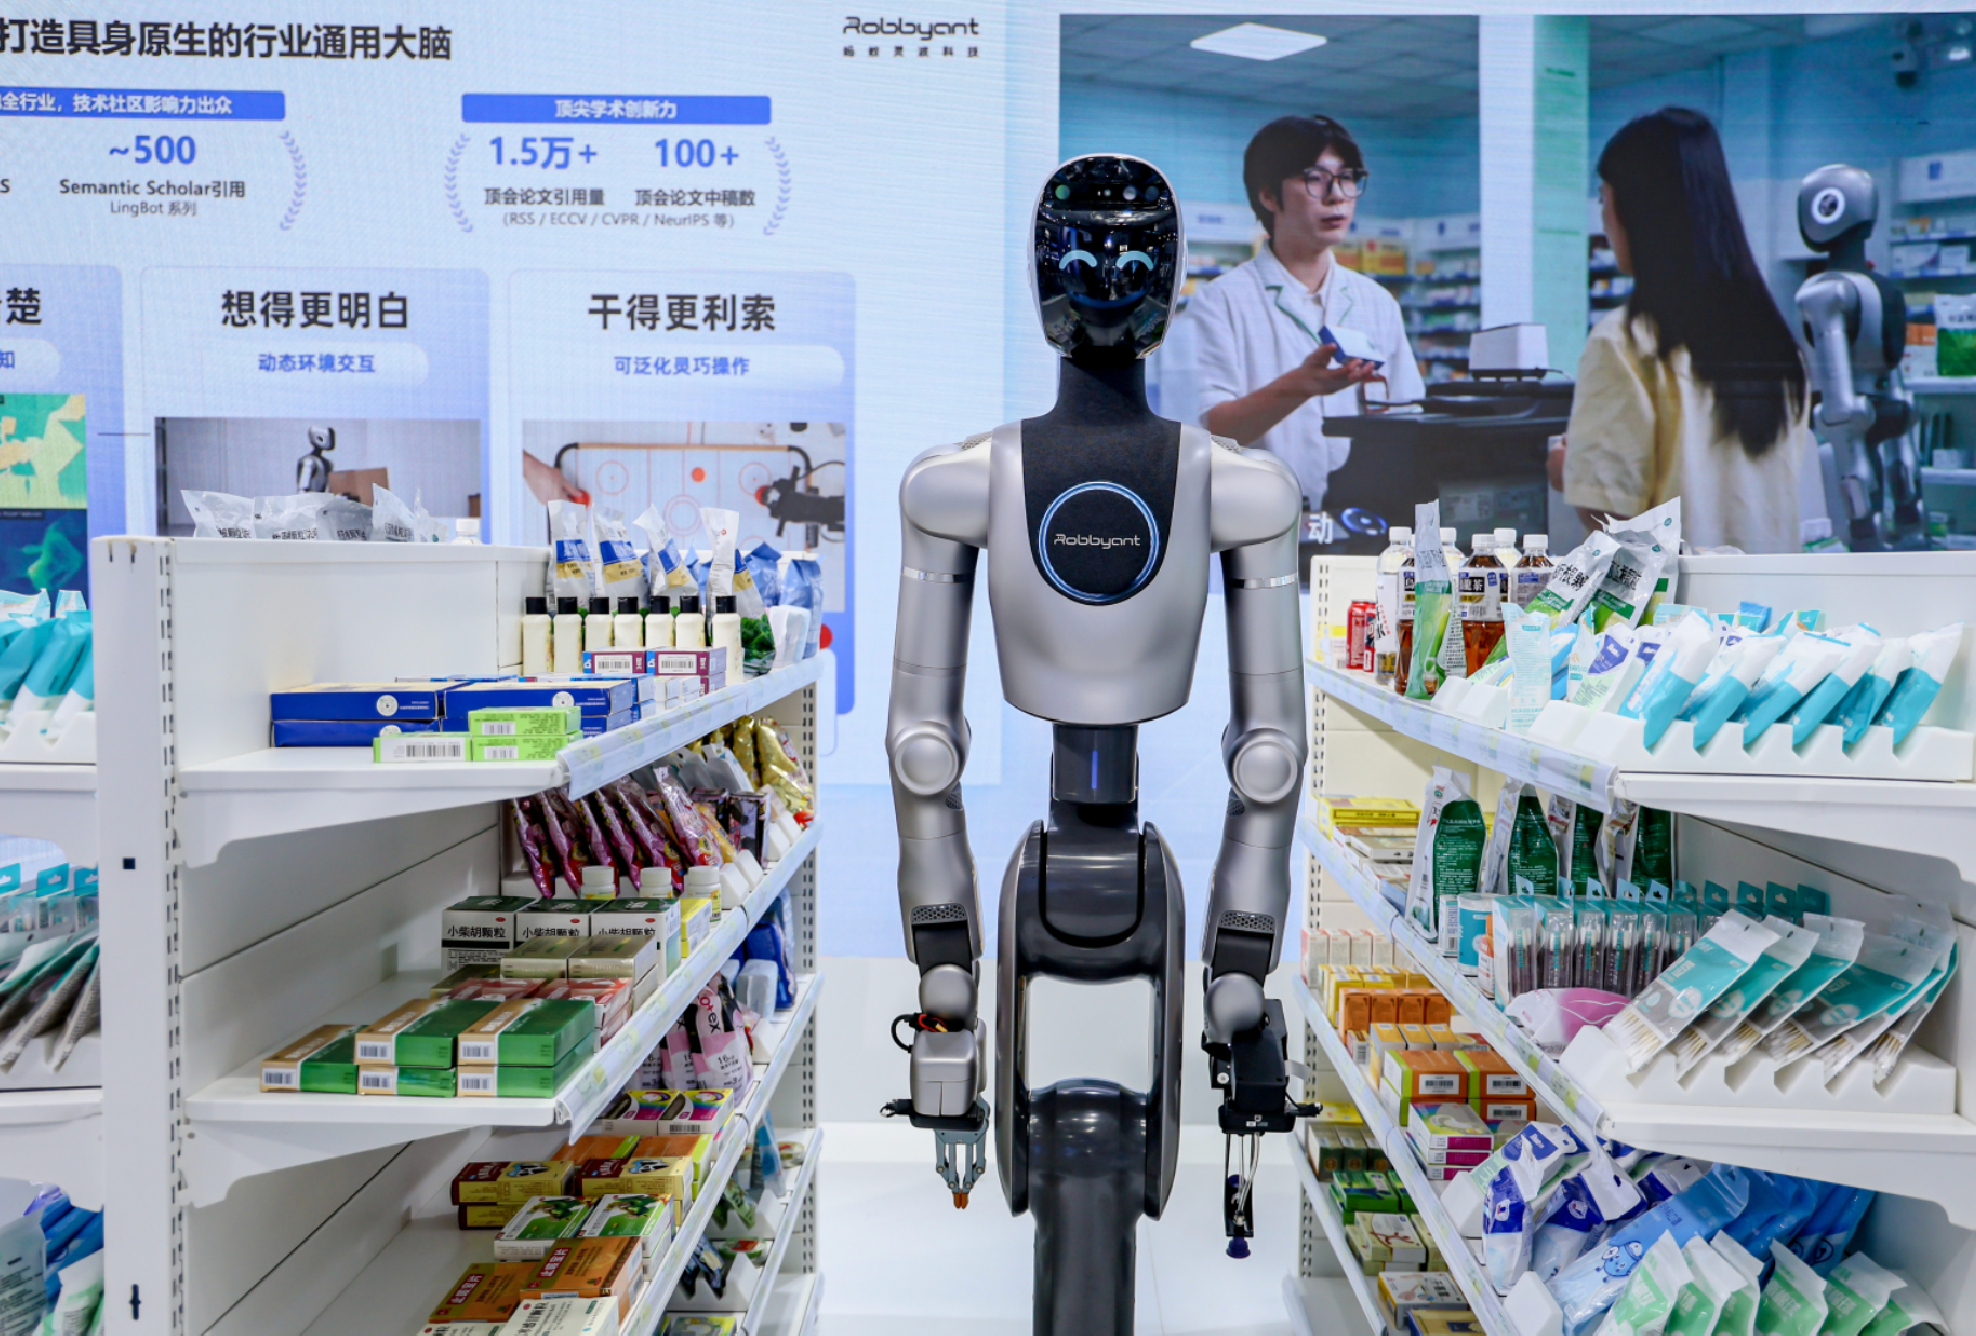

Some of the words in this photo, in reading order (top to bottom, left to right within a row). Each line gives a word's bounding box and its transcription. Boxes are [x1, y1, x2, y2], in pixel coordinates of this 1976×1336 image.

[0, 17, 452, 60] 打造具身原生的行业通用大脑
[843, 17, 979, 41] Robbyant
[555, 99, 677, 118] 顶尖学术创新力
[109, 135, 196, 164] ~500
[490, 136, 597, 169] 1.5万+
[655, 138, 739, 168] 100+
[60, 179, 140, 195] Semantic
[147, 180, 246, 198] Scholar引用
[485, 188, 604, 206] 顶会论文引用量
[635, 189, 755, 207] 顶会论文中稿数
[110, 201, 163, 217] LingBot
[602, 213, 639, 225] CVPR
[7, 287, 42, 325] 楚
[221, 289, 408, 328] 想得更明白
[588, 293, 776, 332] 干得更利索
[258, 353, 376, 373] 动态环境交互
[614, 356, 750, 375] 可泛化灵巧操作
[1308, 511, 1333, 544] 动
[1053, 533, 1141, 549] Robbyant
[447, 925, 506, 938] 小柴胡颗粒
